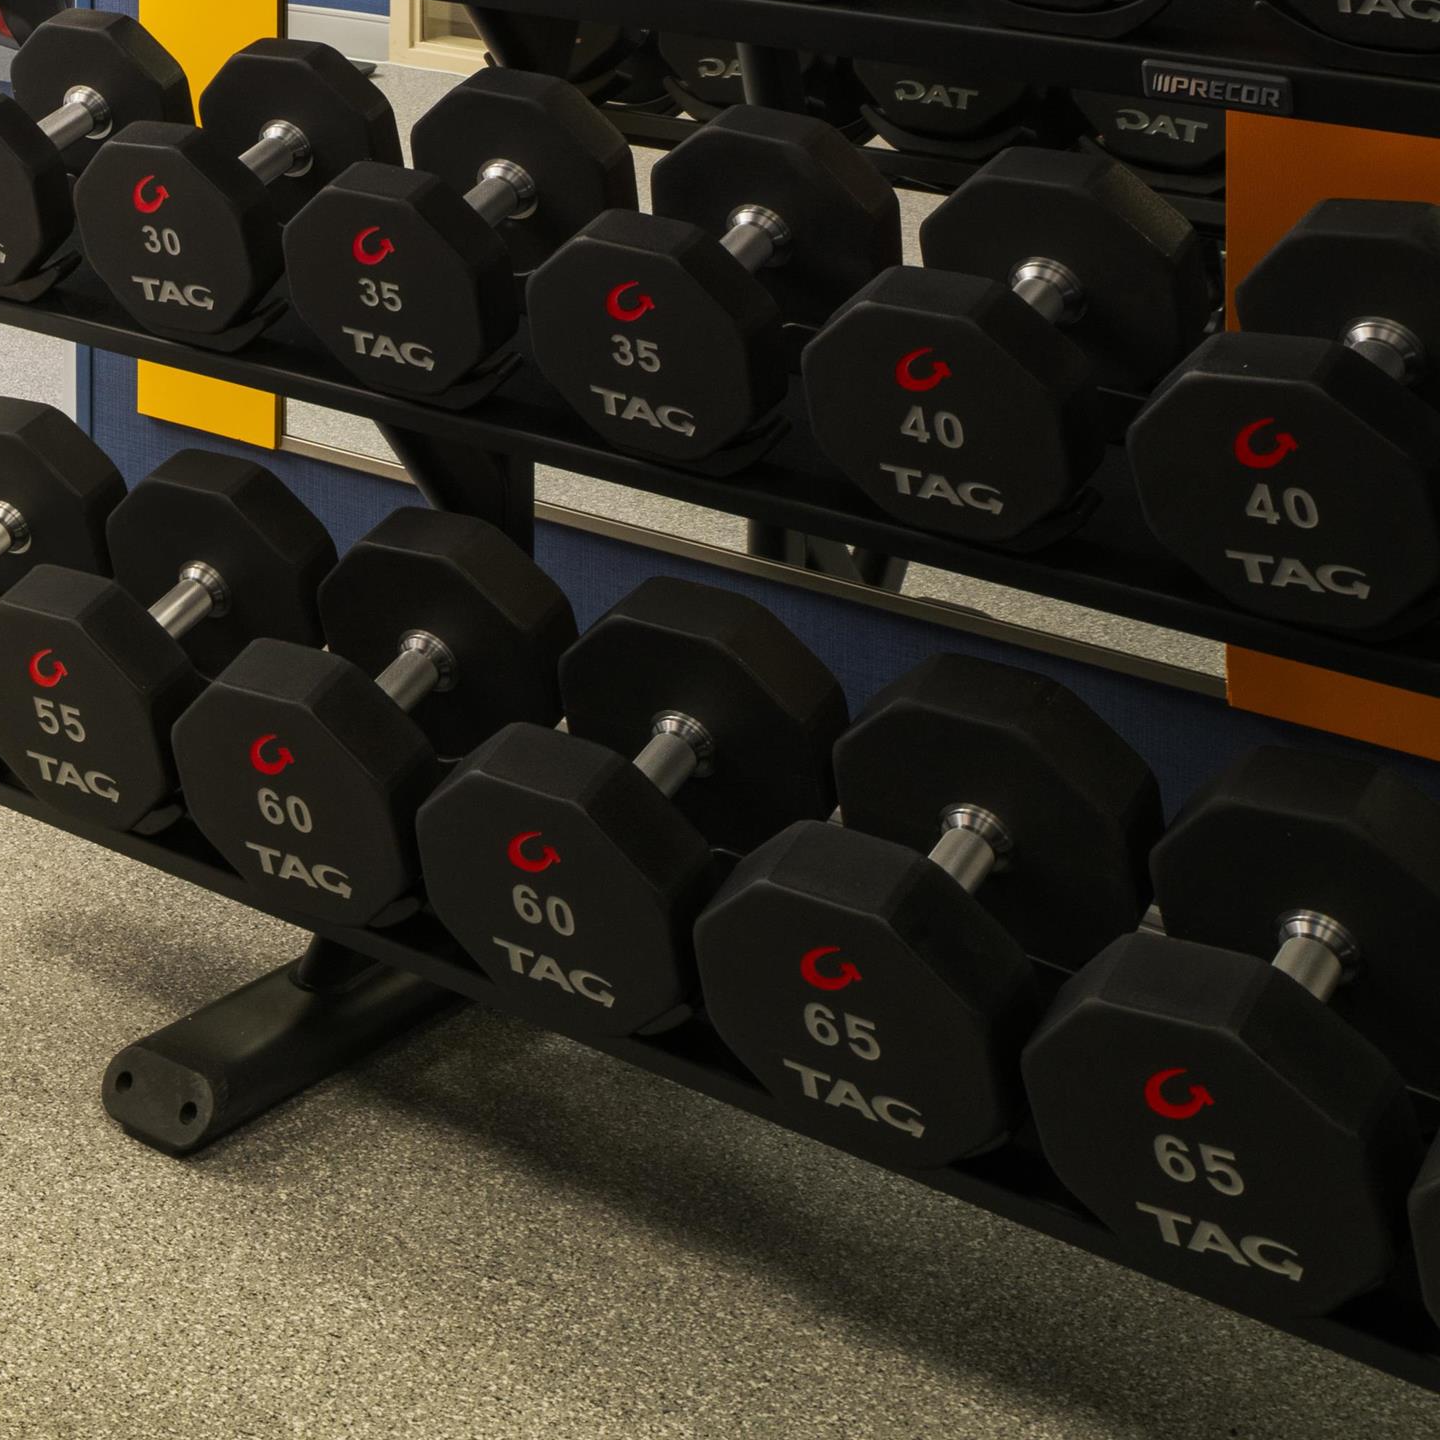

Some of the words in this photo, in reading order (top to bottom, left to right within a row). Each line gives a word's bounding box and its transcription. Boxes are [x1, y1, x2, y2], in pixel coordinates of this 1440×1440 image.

[1170, 76, 1279, 107] PRECOR
[142, 226, 180, 255] 30
[132, 276, 213, 310] TAG
[359, 279, 402, 311] 35
[342, 326, 434, 371] TAG
[612, 335, 660, 372] 35
[590, 385, 695, 437] TAG
[901, 406, 963, 448] 40
[880, 463, 1003, 515] TAG
[1246, 484, 1318, 528] 40
[1225, 550, 1370, 599] TAG
[34, 697, 85, 742] 55
[26, 750, 119, 803] TAG
[258, 788, 312, 833] 60
[245, 841, 352, 899] TAG
[513, 885, 574, 936] 60
[493, 937, 615, 1008] TAG
[804, 1003, 880, 1060] 65
[782, 1058, 926, 1138] TAG
[1154, 1135, 1244, 1196] 65
[1135, 1201, 1305, 1282] TAG
